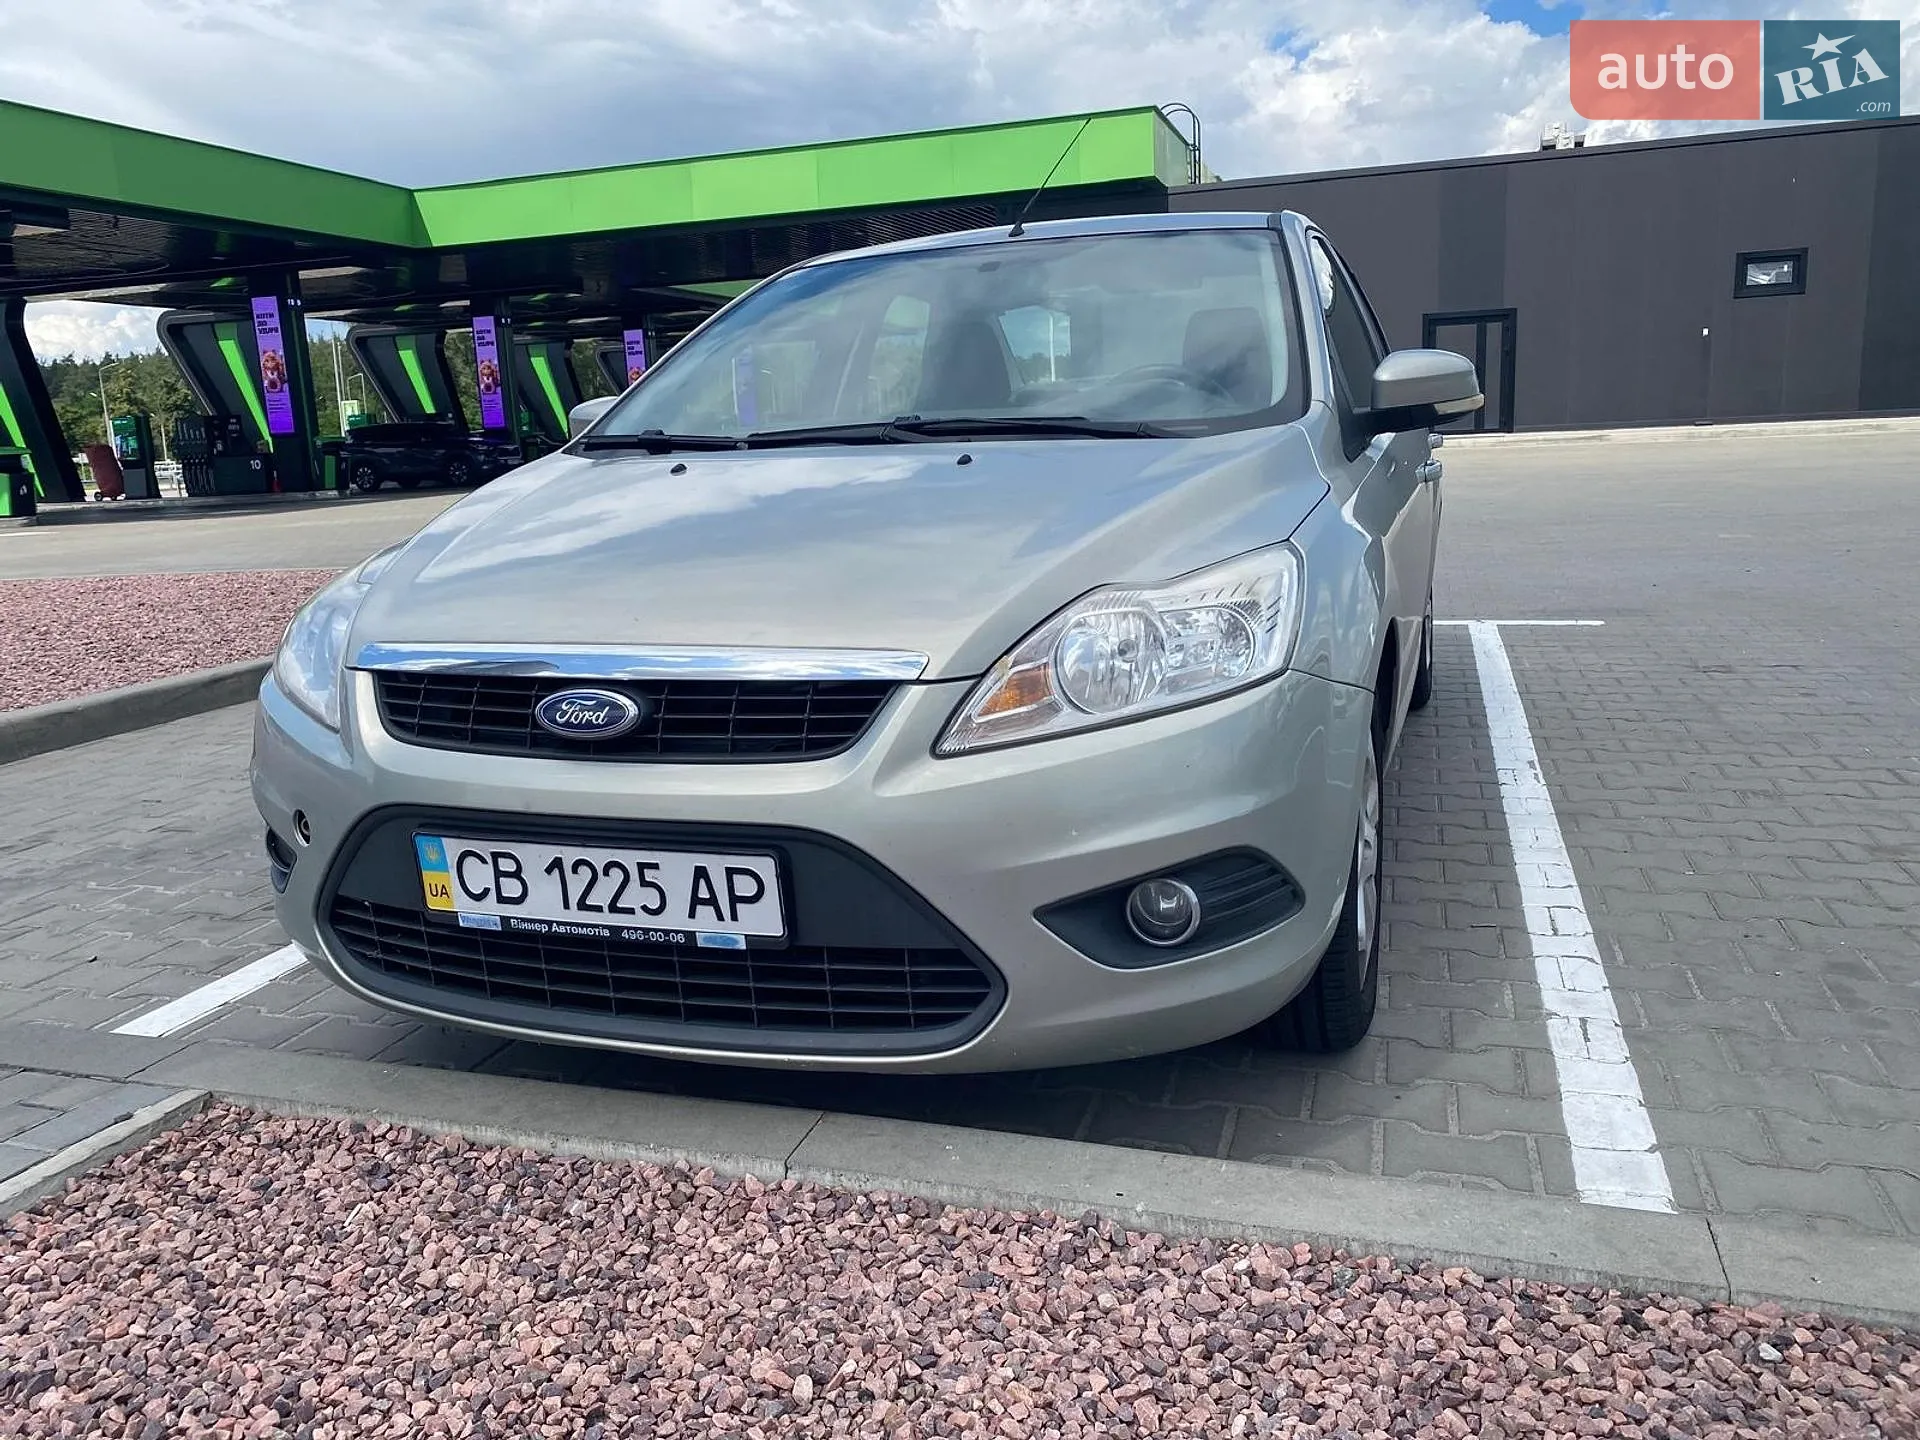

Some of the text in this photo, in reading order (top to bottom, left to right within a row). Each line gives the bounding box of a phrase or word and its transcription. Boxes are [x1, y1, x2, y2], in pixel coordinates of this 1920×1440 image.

[249, 459, 262, 470] 10
[556, 698, 610, 725] Ford
[428, 882, 451, 900] UA
[455, 849, 767, 922] CB 1225 AP
[510, 918, 549, 934] Віннер
[551, 922, 611, 937] Автомотів
[621, 929, 686, 944] 496-00-06
